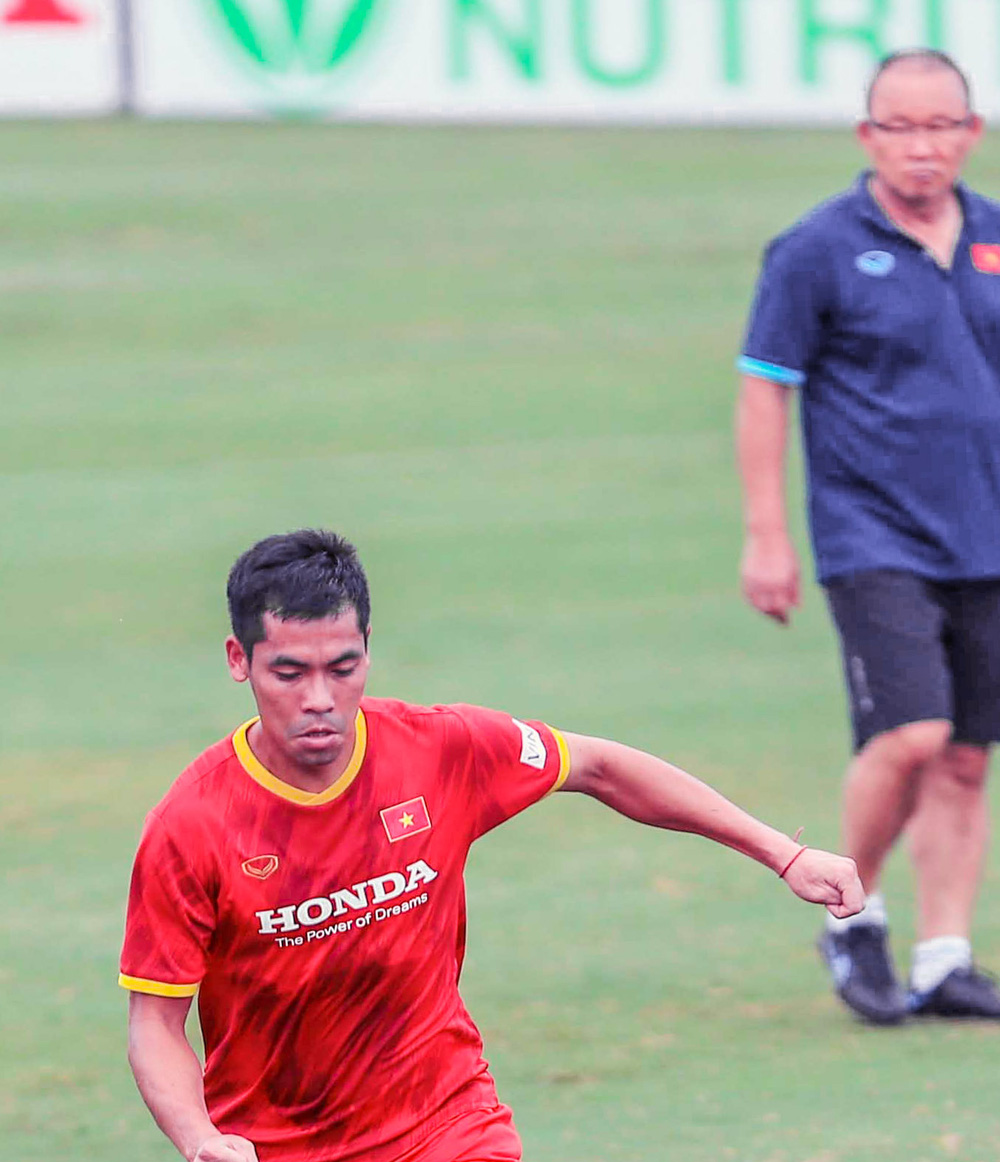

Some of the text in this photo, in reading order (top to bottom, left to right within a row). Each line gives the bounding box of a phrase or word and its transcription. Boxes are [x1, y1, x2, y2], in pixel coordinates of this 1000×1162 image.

[255, 859, 438, 934] HONDA
[274, 892, 429, 948] The Power of Dreams
